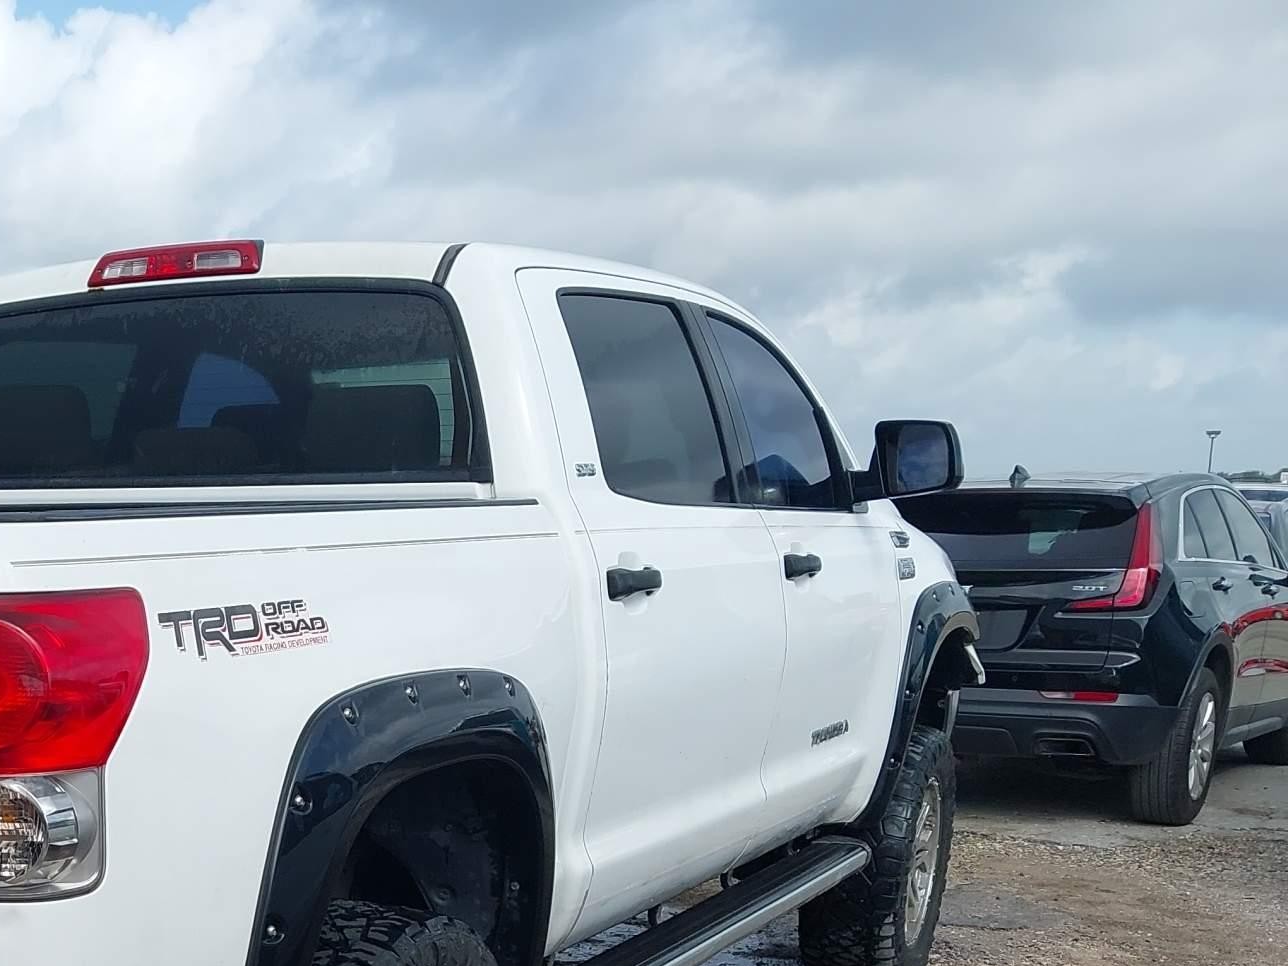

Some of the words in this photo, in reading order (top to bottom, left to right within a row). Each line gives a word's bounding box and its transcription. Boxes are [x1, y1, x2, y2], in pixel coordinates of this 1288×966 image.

[261, 599, 306, 619] OFF
[157, 604, 264, 662] TRD
[264, 616, 329, 640] ROAD
[241, 643, 265, 656] TOYOTA
[265, 640, 287, 652] RACING
[287, 635, 329, 649] DEVELOPMENT
